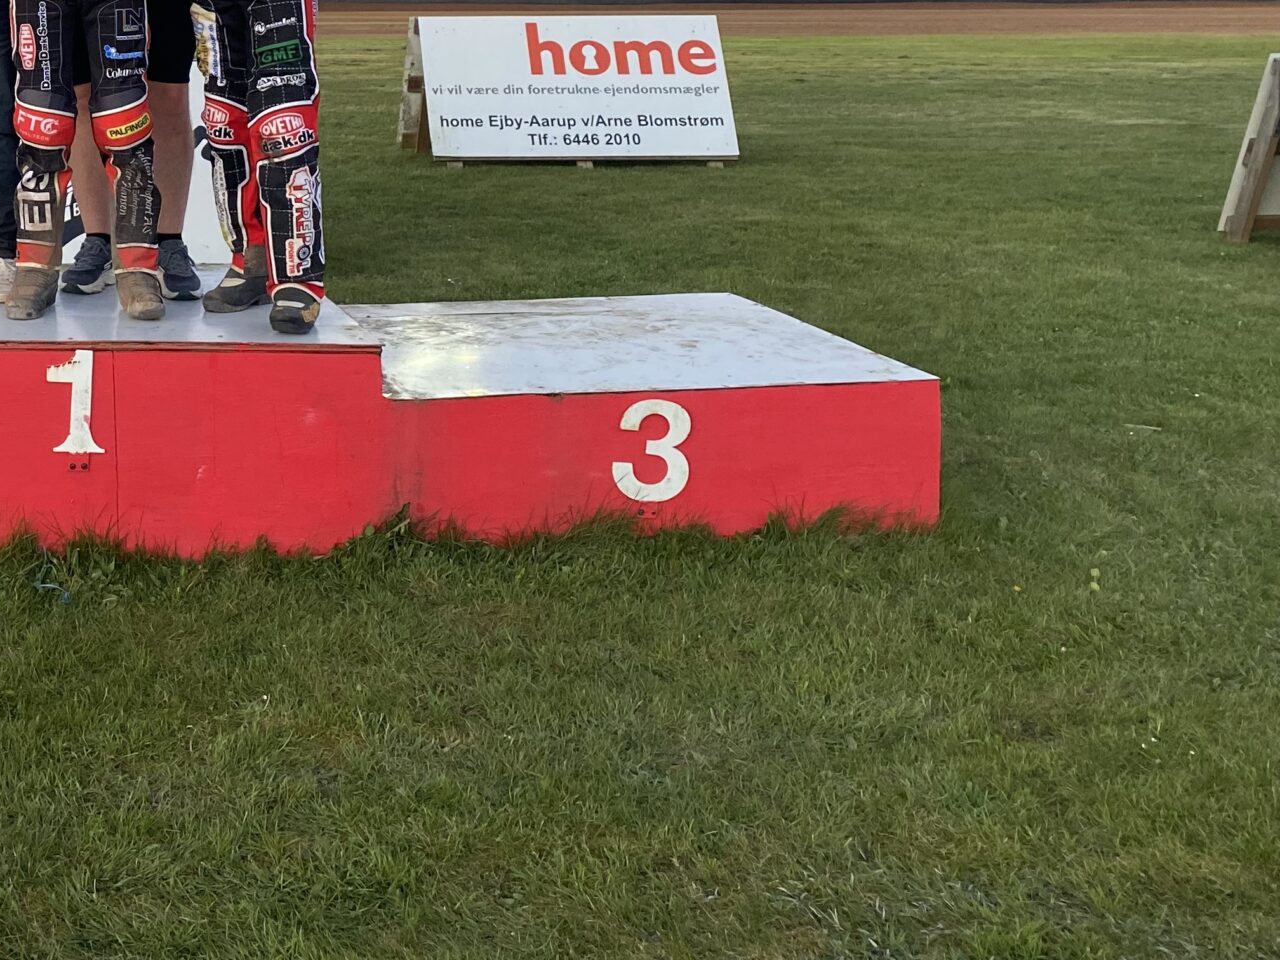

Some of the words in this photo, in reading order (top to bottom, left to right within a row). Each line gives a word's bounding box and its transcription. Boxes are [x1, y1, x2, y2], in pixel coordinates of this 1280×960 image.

[38, 2, 47, 37] Service
[261, 46, 296, 62] GMF
[525, 22, 717, 76] home
[41, 61, 51, 89] Dansk
[432, 84, 444, 95] vi
[447, 83, 462, 95] vil
[465, 86, 499, 95] være
[503, 83, 524, 95] din
[528, 83, 600, 95] foretrukne
[603, 83, 720, 98] ejendomsmægler
[109, 115, 150, 138] PALFINGER
[261, 115, 303, 135] OVETHI
[440, 115, 483, 127] home
[489, 115, 577, 130] Ejby-Aarup
[581, 114, 632, 128] v/Arne
[637, 114, 724, 128] Blomstrøm
[262, 130, 315, 153] dæk.dk
[563, 133, 600, 146] 6446
[605, 133, 641, 146] 2010
[45, 350, 105, 454] 1
[610, 399, 691, 503] 3
